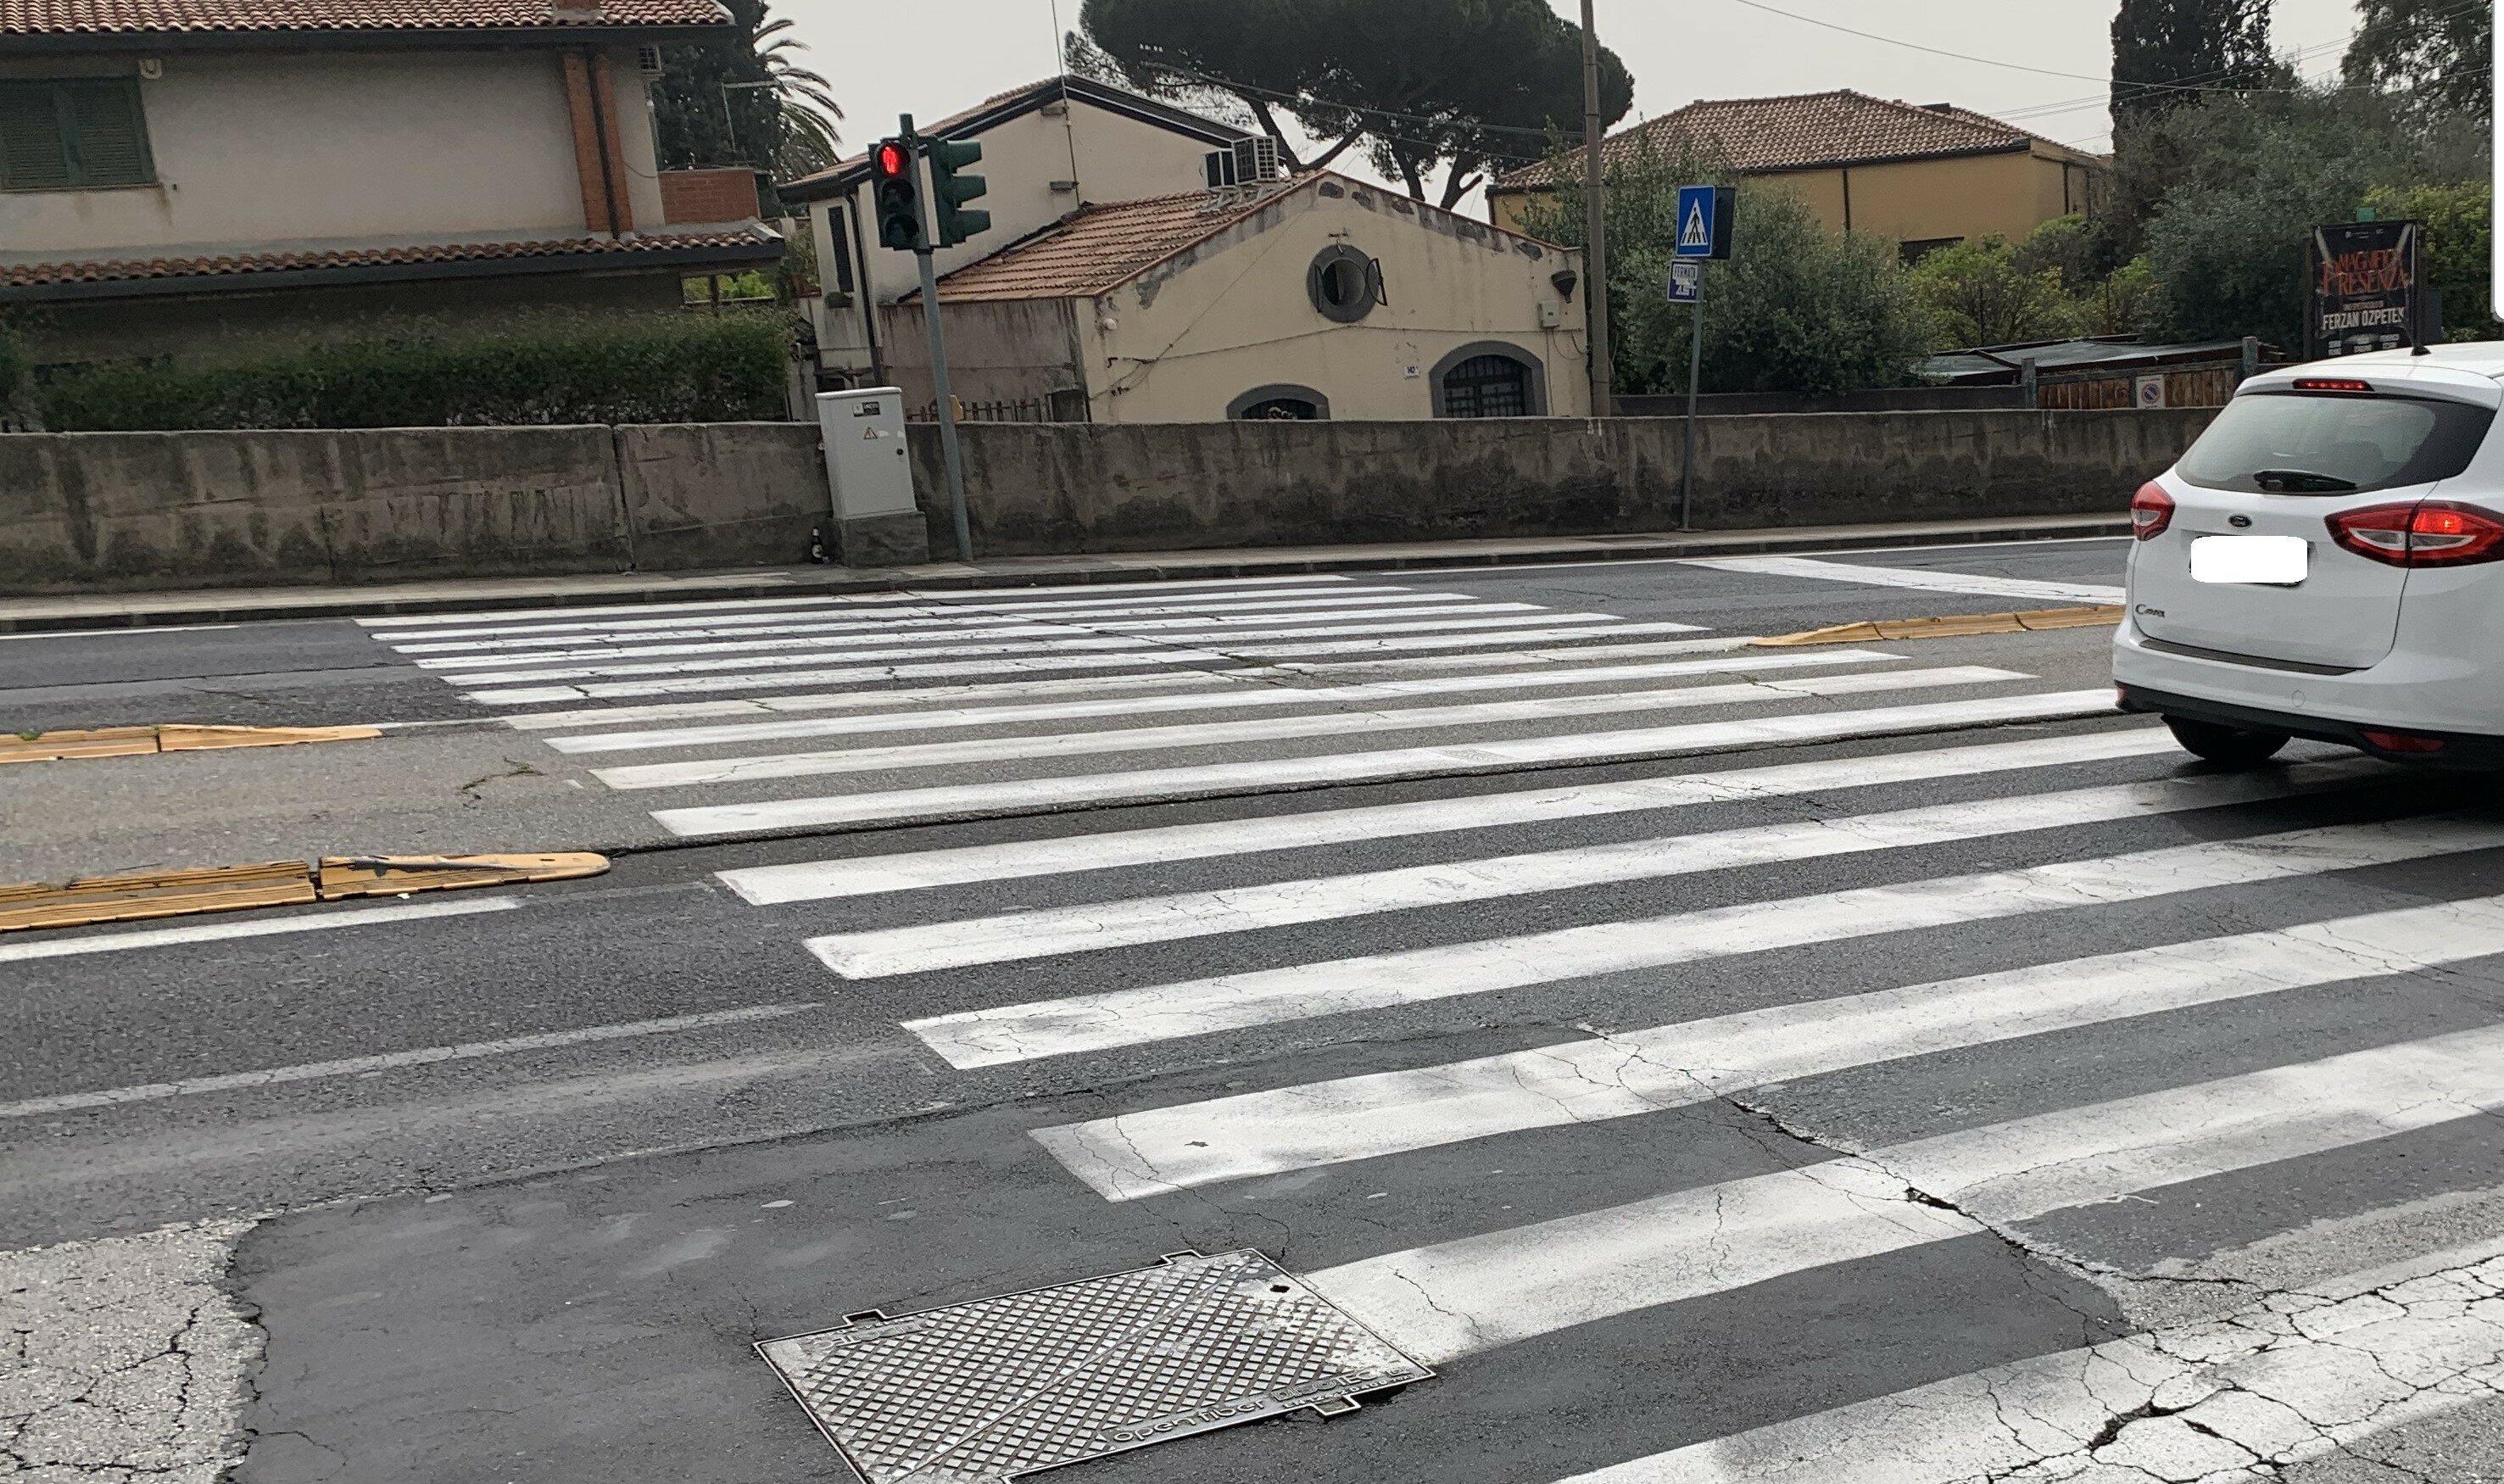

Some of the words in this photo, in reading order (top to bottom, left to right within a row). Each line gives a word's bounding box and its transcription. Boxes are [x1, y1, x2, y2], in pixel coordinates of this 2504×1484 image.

[2323, 312, 2360, 331] FERZAN
[1113, 1417, 1196, 1442] open
[1197, 1399, 1265, 1422] fiber
